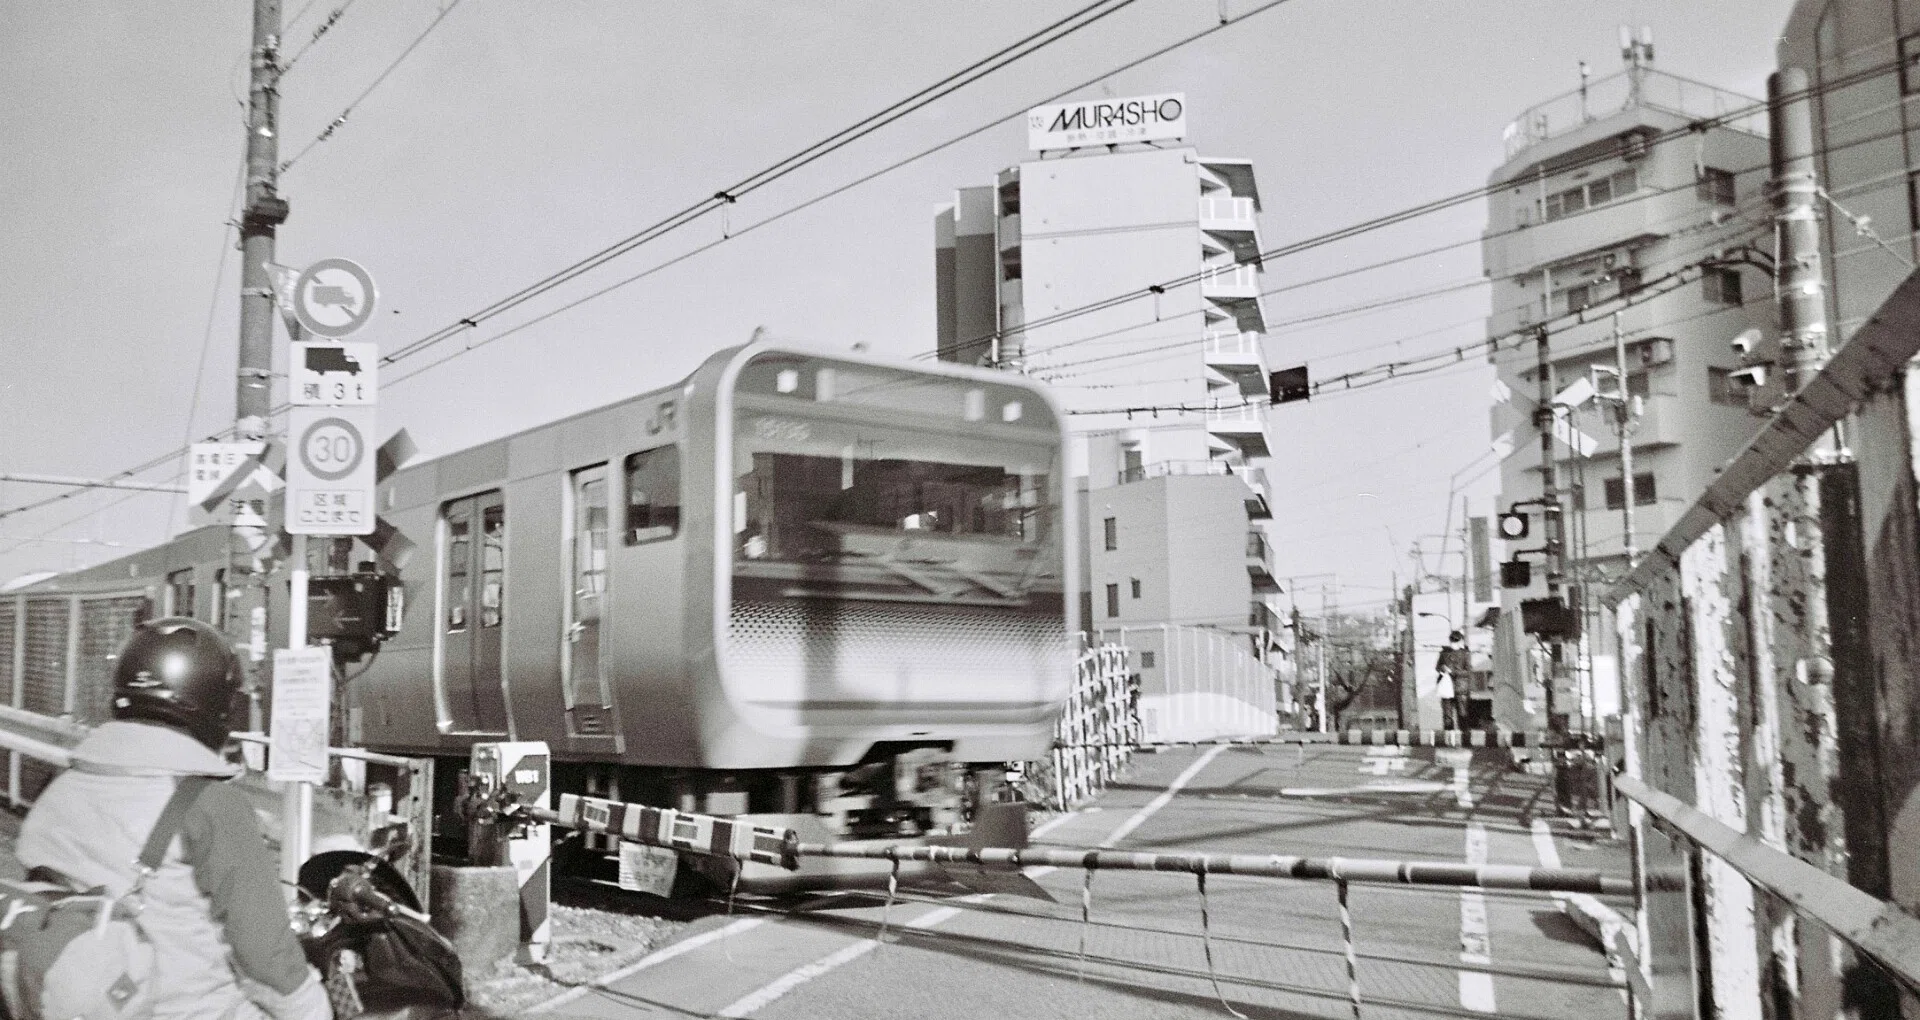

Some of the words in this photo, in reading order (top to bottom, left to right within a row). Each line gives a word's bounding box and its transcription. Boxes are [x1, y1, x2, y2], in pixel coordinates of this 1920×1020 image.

[1049, 98, 1182, 132] MURASHO
[333, 382, 345, 400] 3
[315, 435, 350, 462] 30
[301, 510, 360, 522] ここまで
